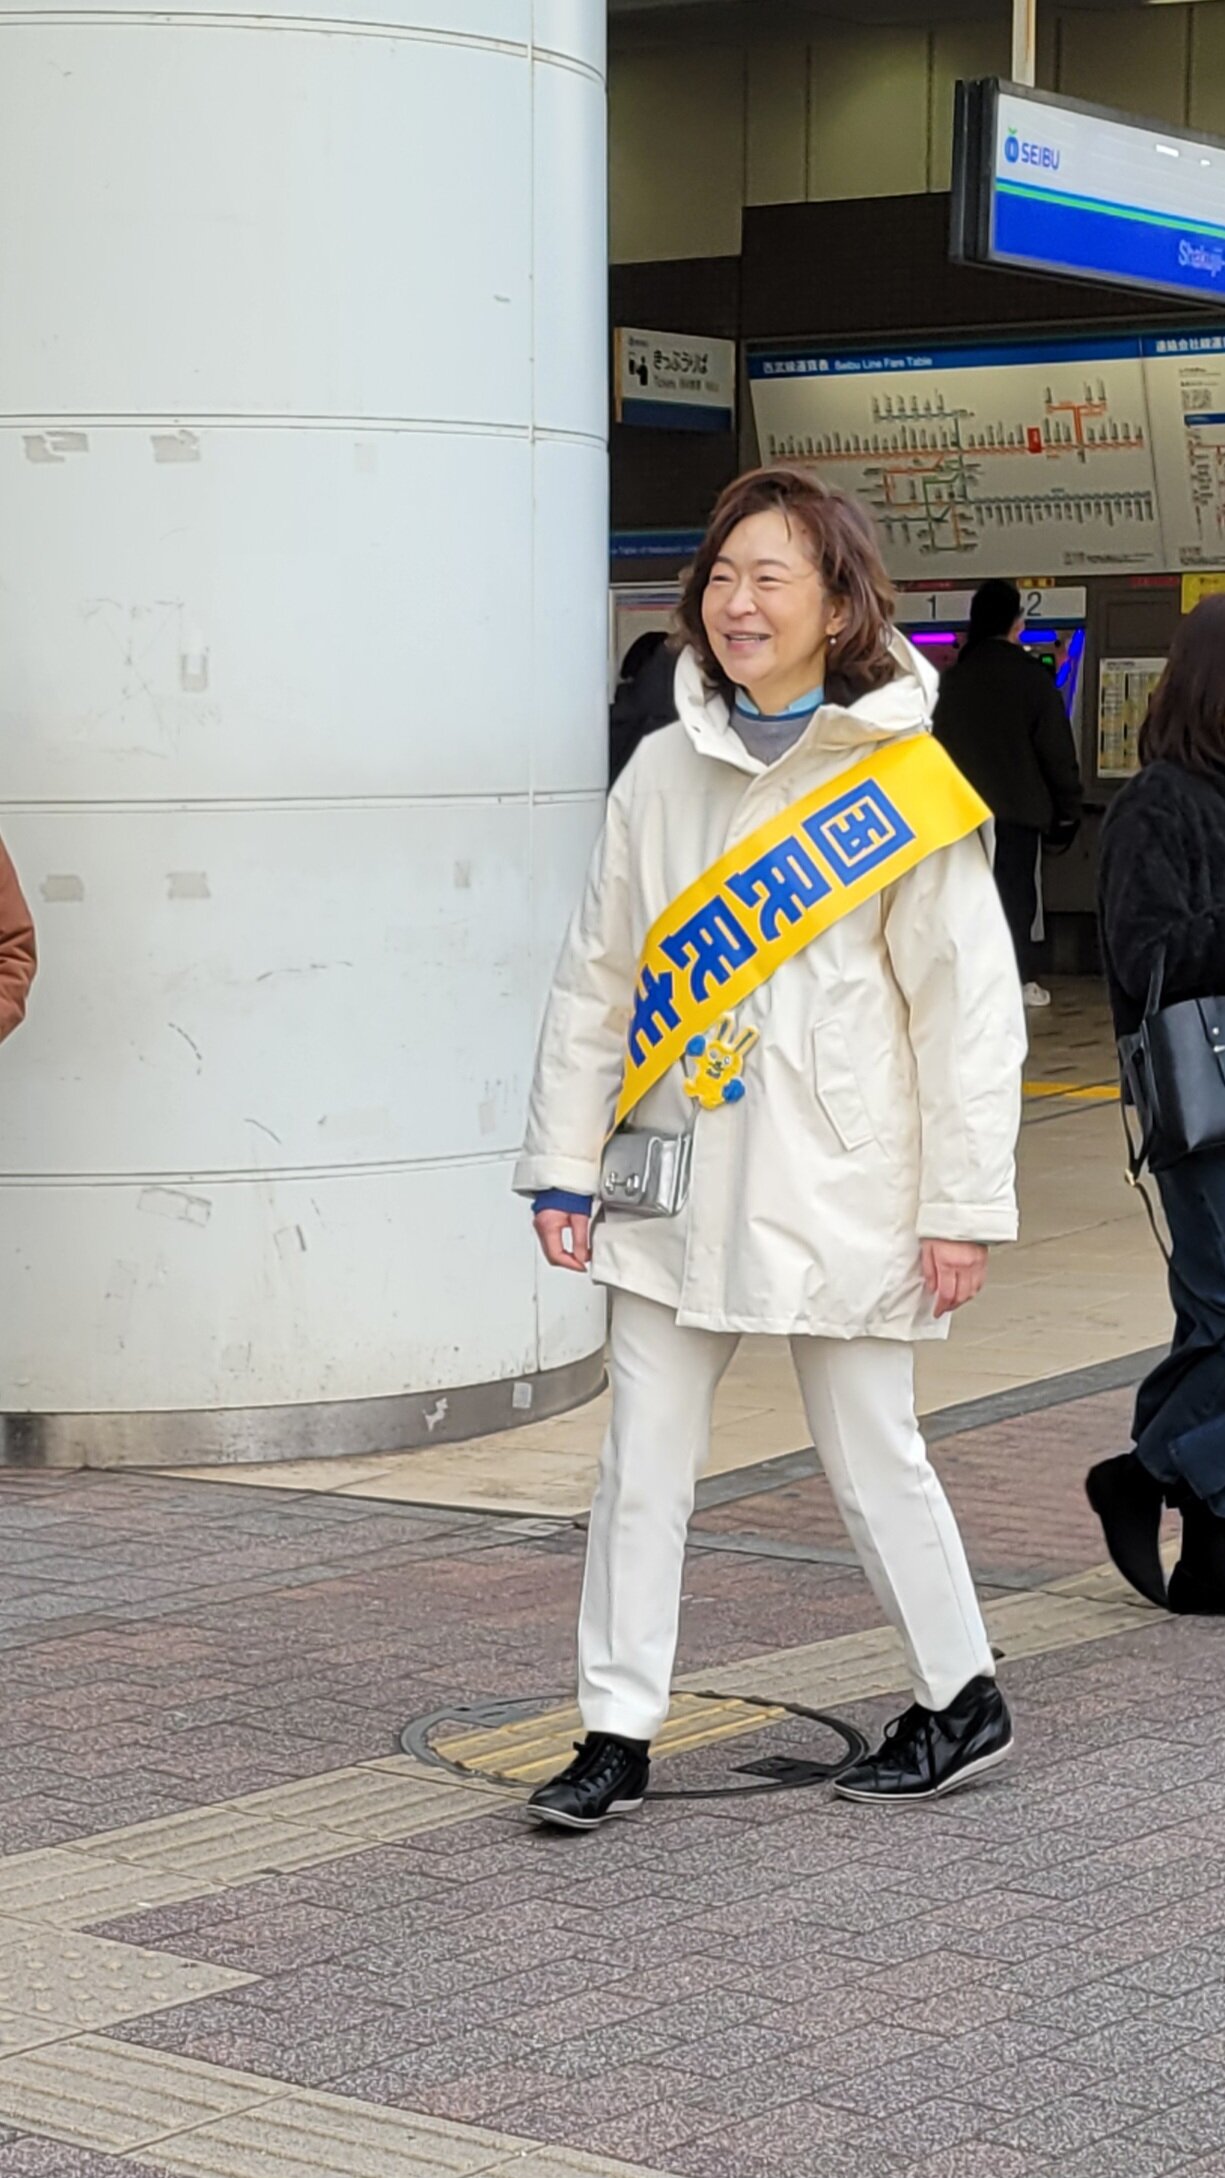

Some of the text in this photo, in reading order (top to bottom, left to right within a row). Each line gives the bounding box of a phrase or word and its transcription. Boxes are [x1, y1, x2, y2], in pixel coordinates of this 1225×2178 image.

[1021, 142, 1060, 171] SEIBU
[862, 358, 882, 369] Line
[884, 357, 905, 368] Fare
[906, 356, 933, 367] Table
[927, 595, 936, 620] 1
[1027, 591, 1042, 617] 2
